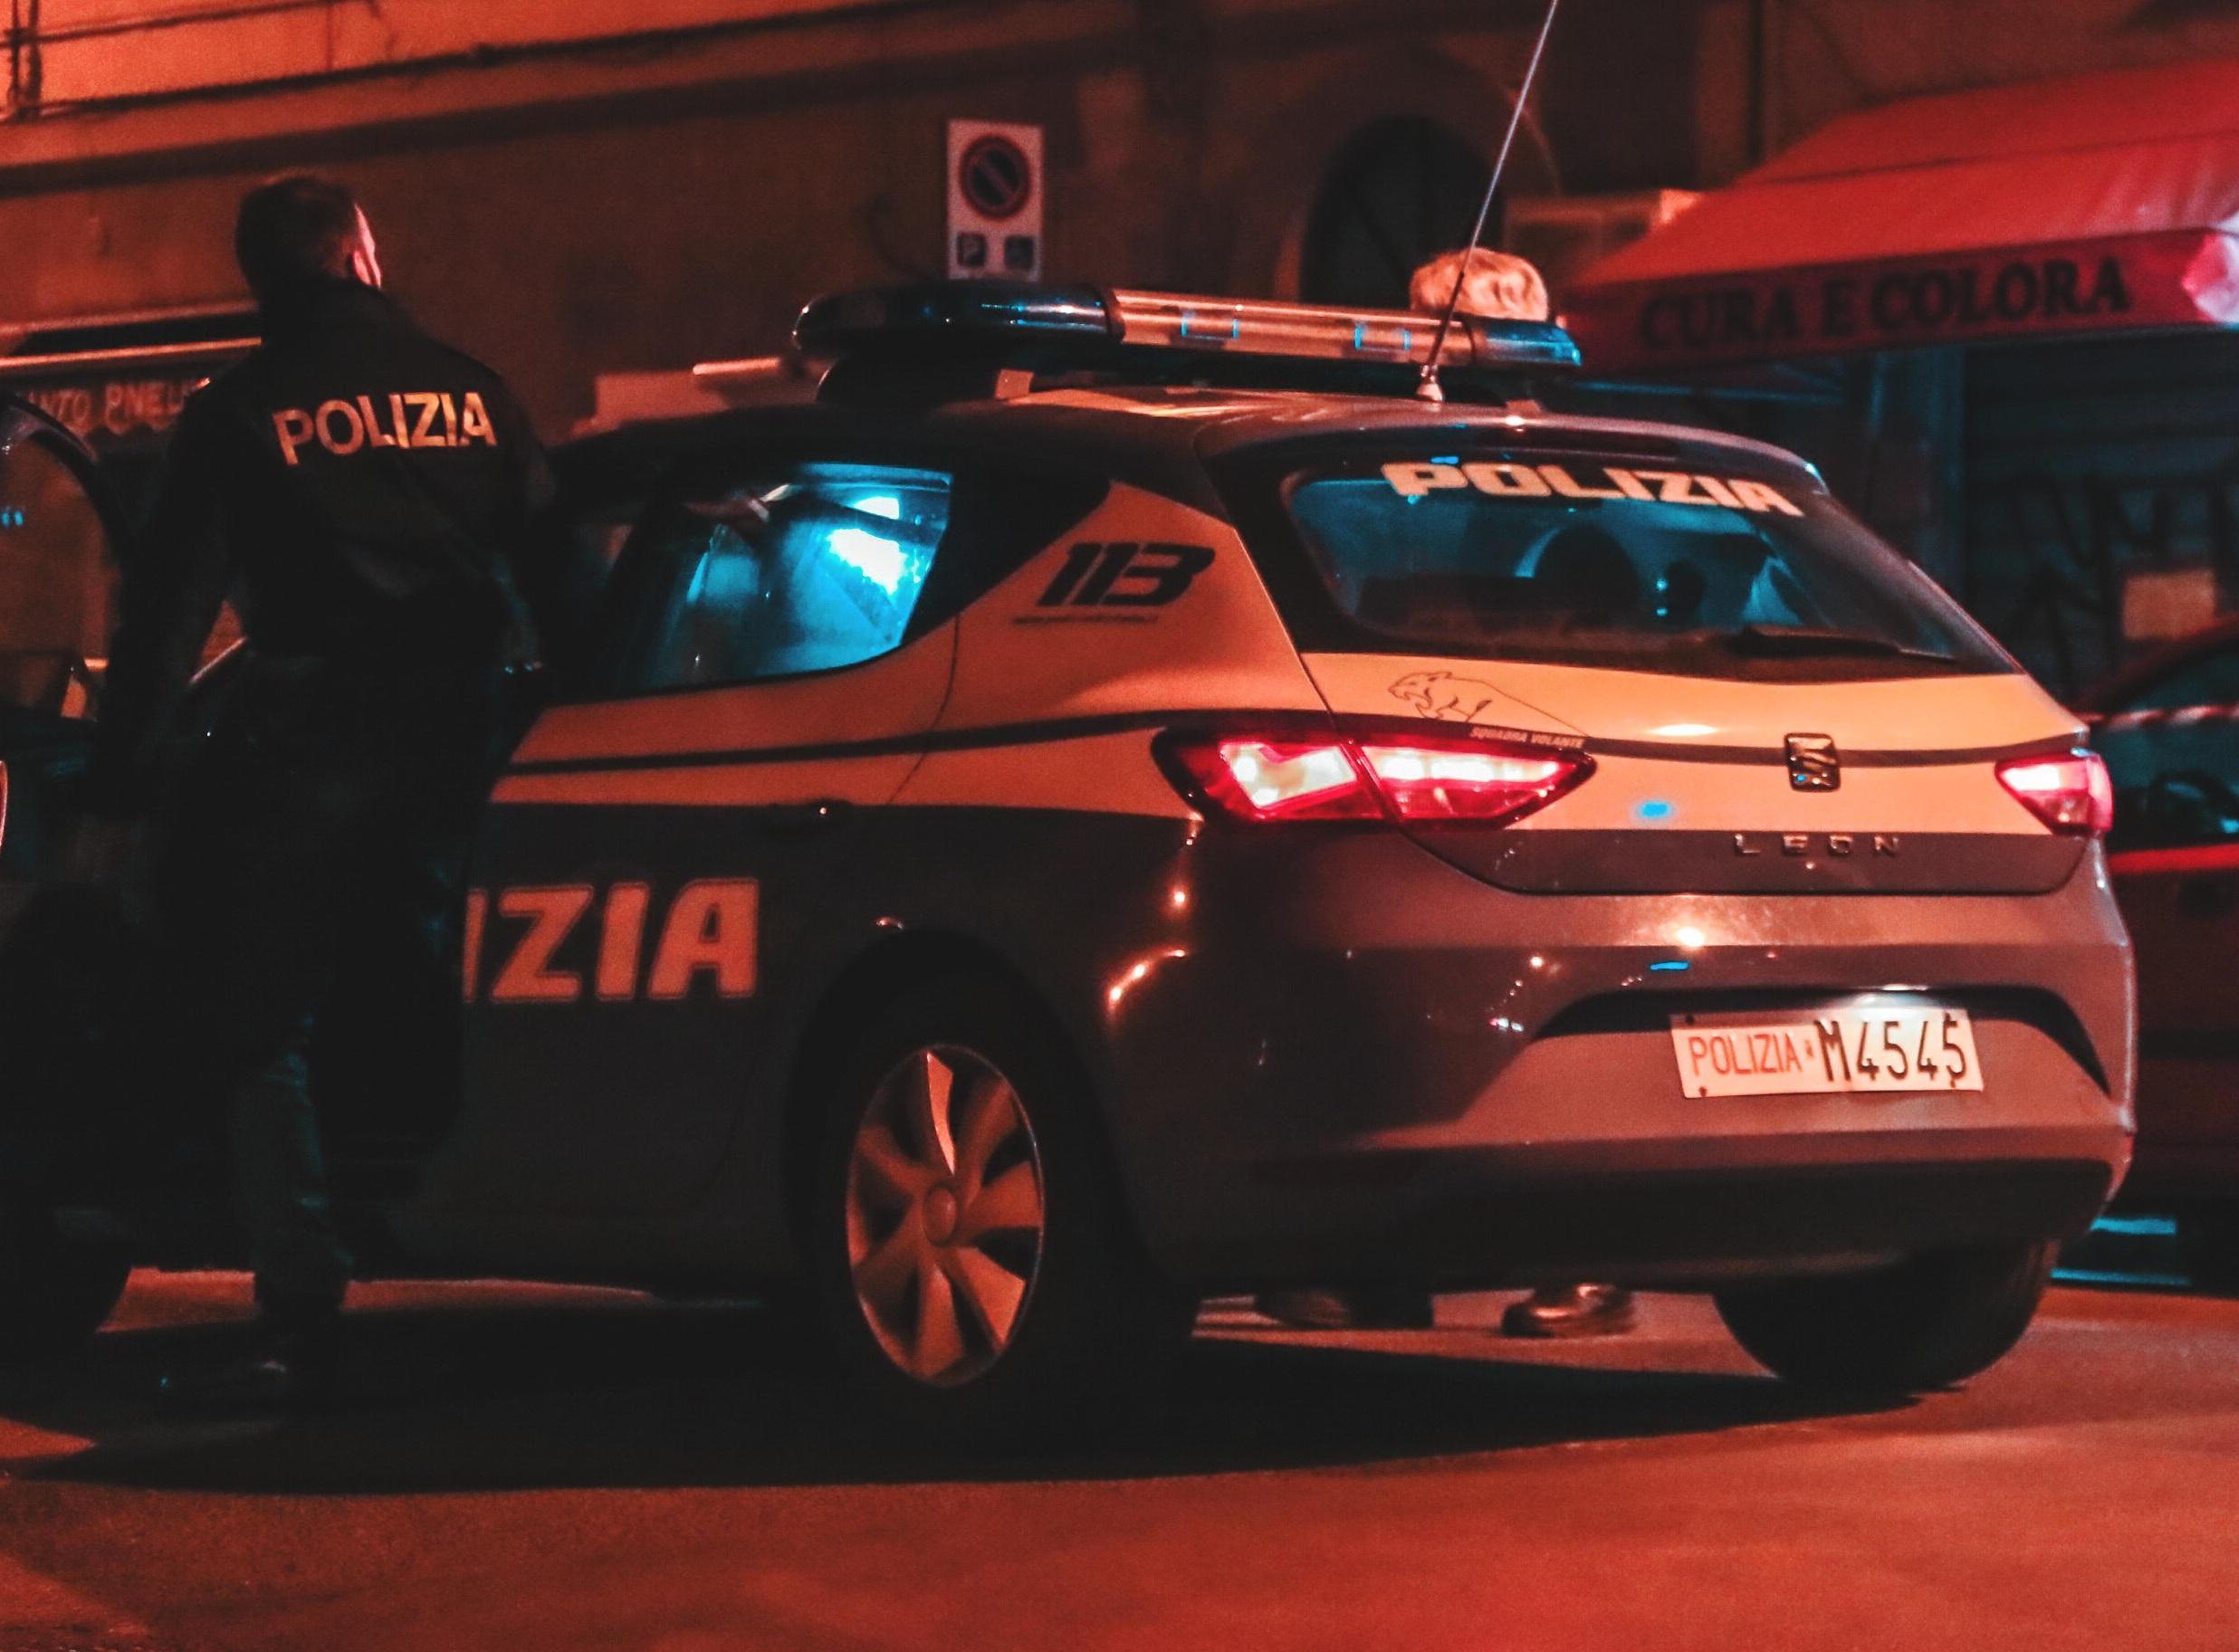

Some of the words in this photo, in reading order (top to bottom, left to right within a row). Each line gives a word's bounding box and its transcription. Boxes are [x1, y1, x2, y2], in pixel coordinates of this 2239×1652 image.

[1822, 278, 1858, 336] E
[1871, 257, 2131, 329] COLORA
[273, 392, 497, 464] POLIZIA
[1381, 462, 1804, 517] POLIZIA
[1037, 542, 1216, 606] 113
[1734, 833, 1899, 855] LEON
[1688, 1033, 1803, 1076] POLIZIA
[1813, 1020, 1966, 1082] M4545
